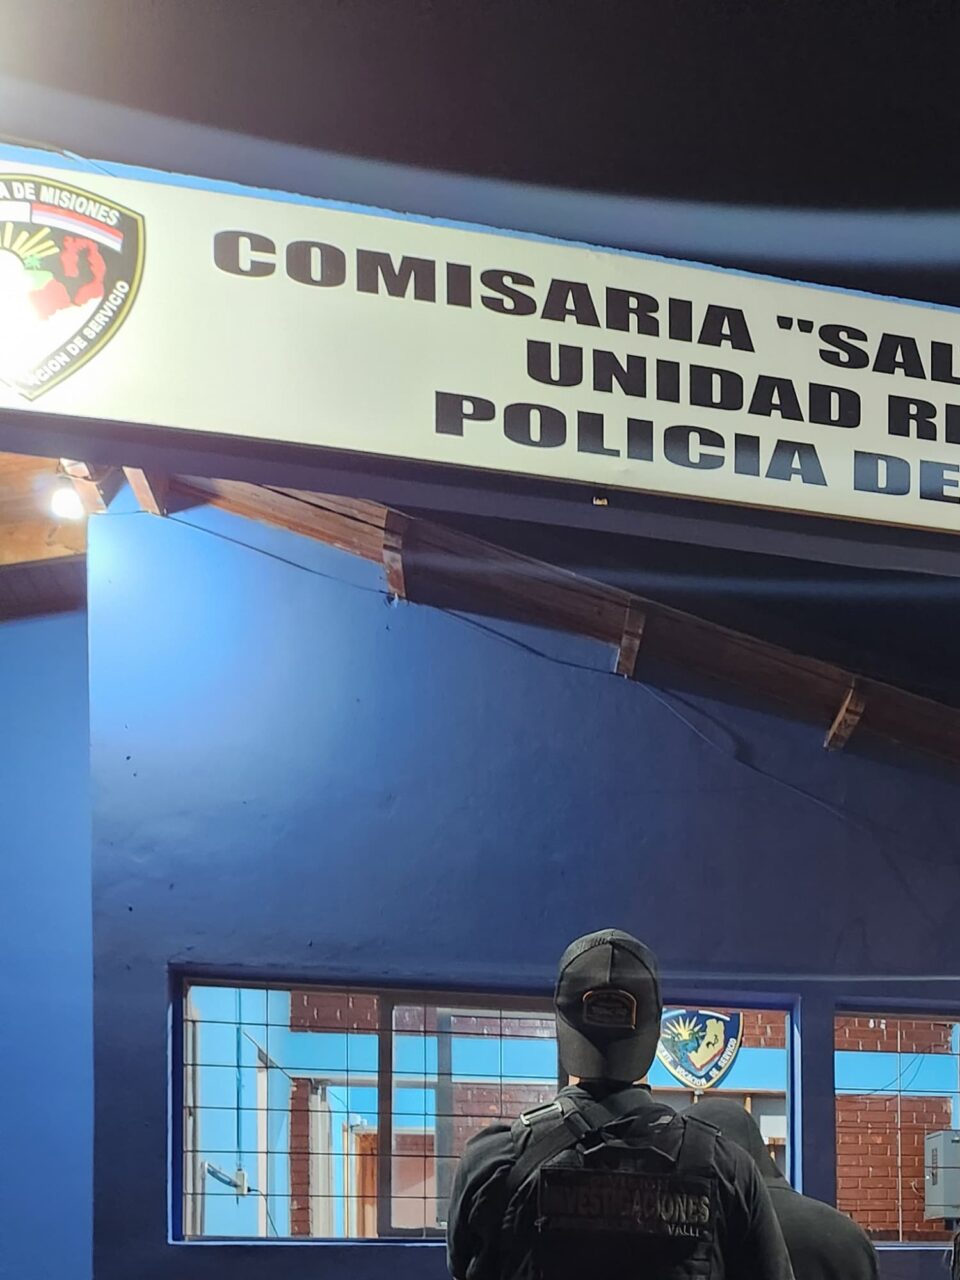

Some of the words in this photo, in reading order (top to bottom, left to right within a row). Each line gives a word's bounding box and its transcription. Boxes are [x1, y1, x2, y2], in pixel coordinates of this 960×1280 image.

[11, 182, 36, 200] DE
[40, 184, 122, 226] MISIONES
[66, 334, 88, 356] DE
[83, 280, 130, 339] SERVICIO
[213, 229, 755, 353] COMISARIA
[526, 339, 861, 429] UNIDAD
[434, 390, 828, 487] POLICIA
